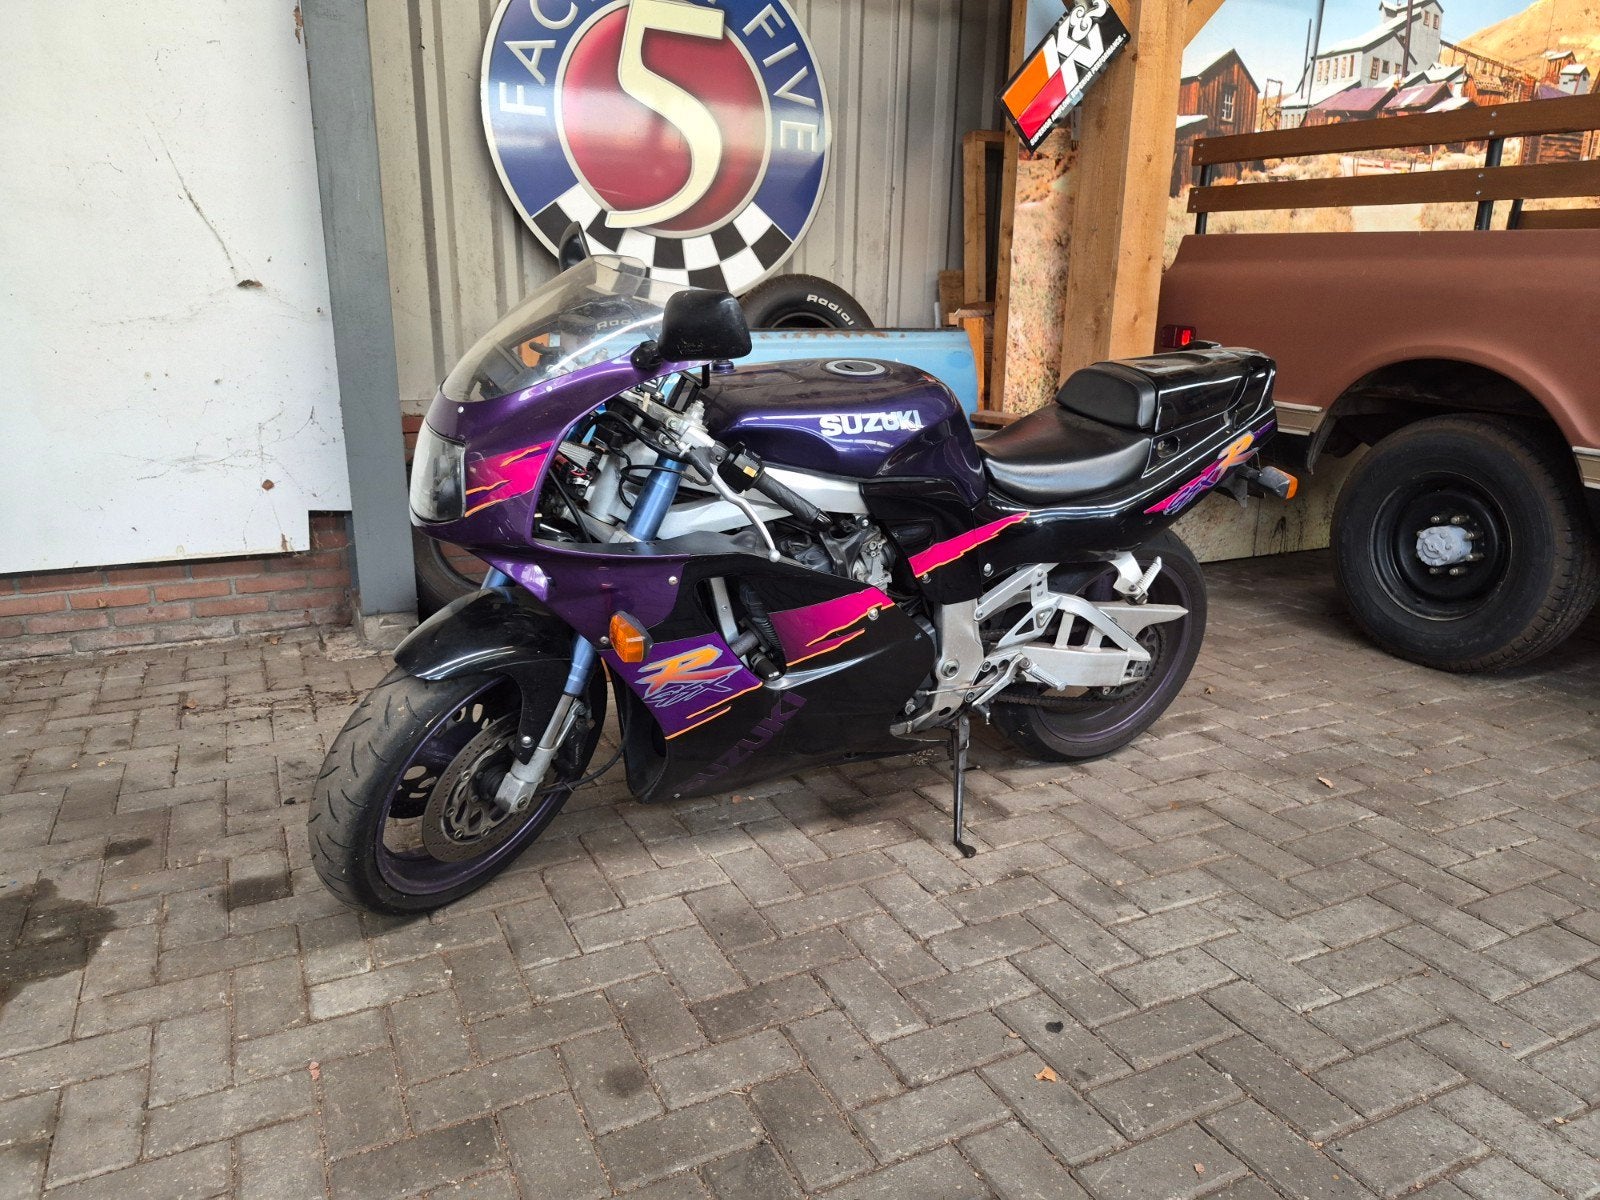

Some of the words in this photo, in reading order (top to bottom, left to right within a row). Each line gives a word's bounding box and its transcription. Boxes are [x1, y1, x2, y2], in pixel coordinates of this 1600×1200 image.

[500, 0, 580, 117] FAC
[742, 3, 818, 153] FIVE
[1042, 0, 1106, 96] K&N
[605, 0, 725, 229] 5
[806, 293, 855, 326] Radial
[819, 409, 922, 437] SUZUKI
